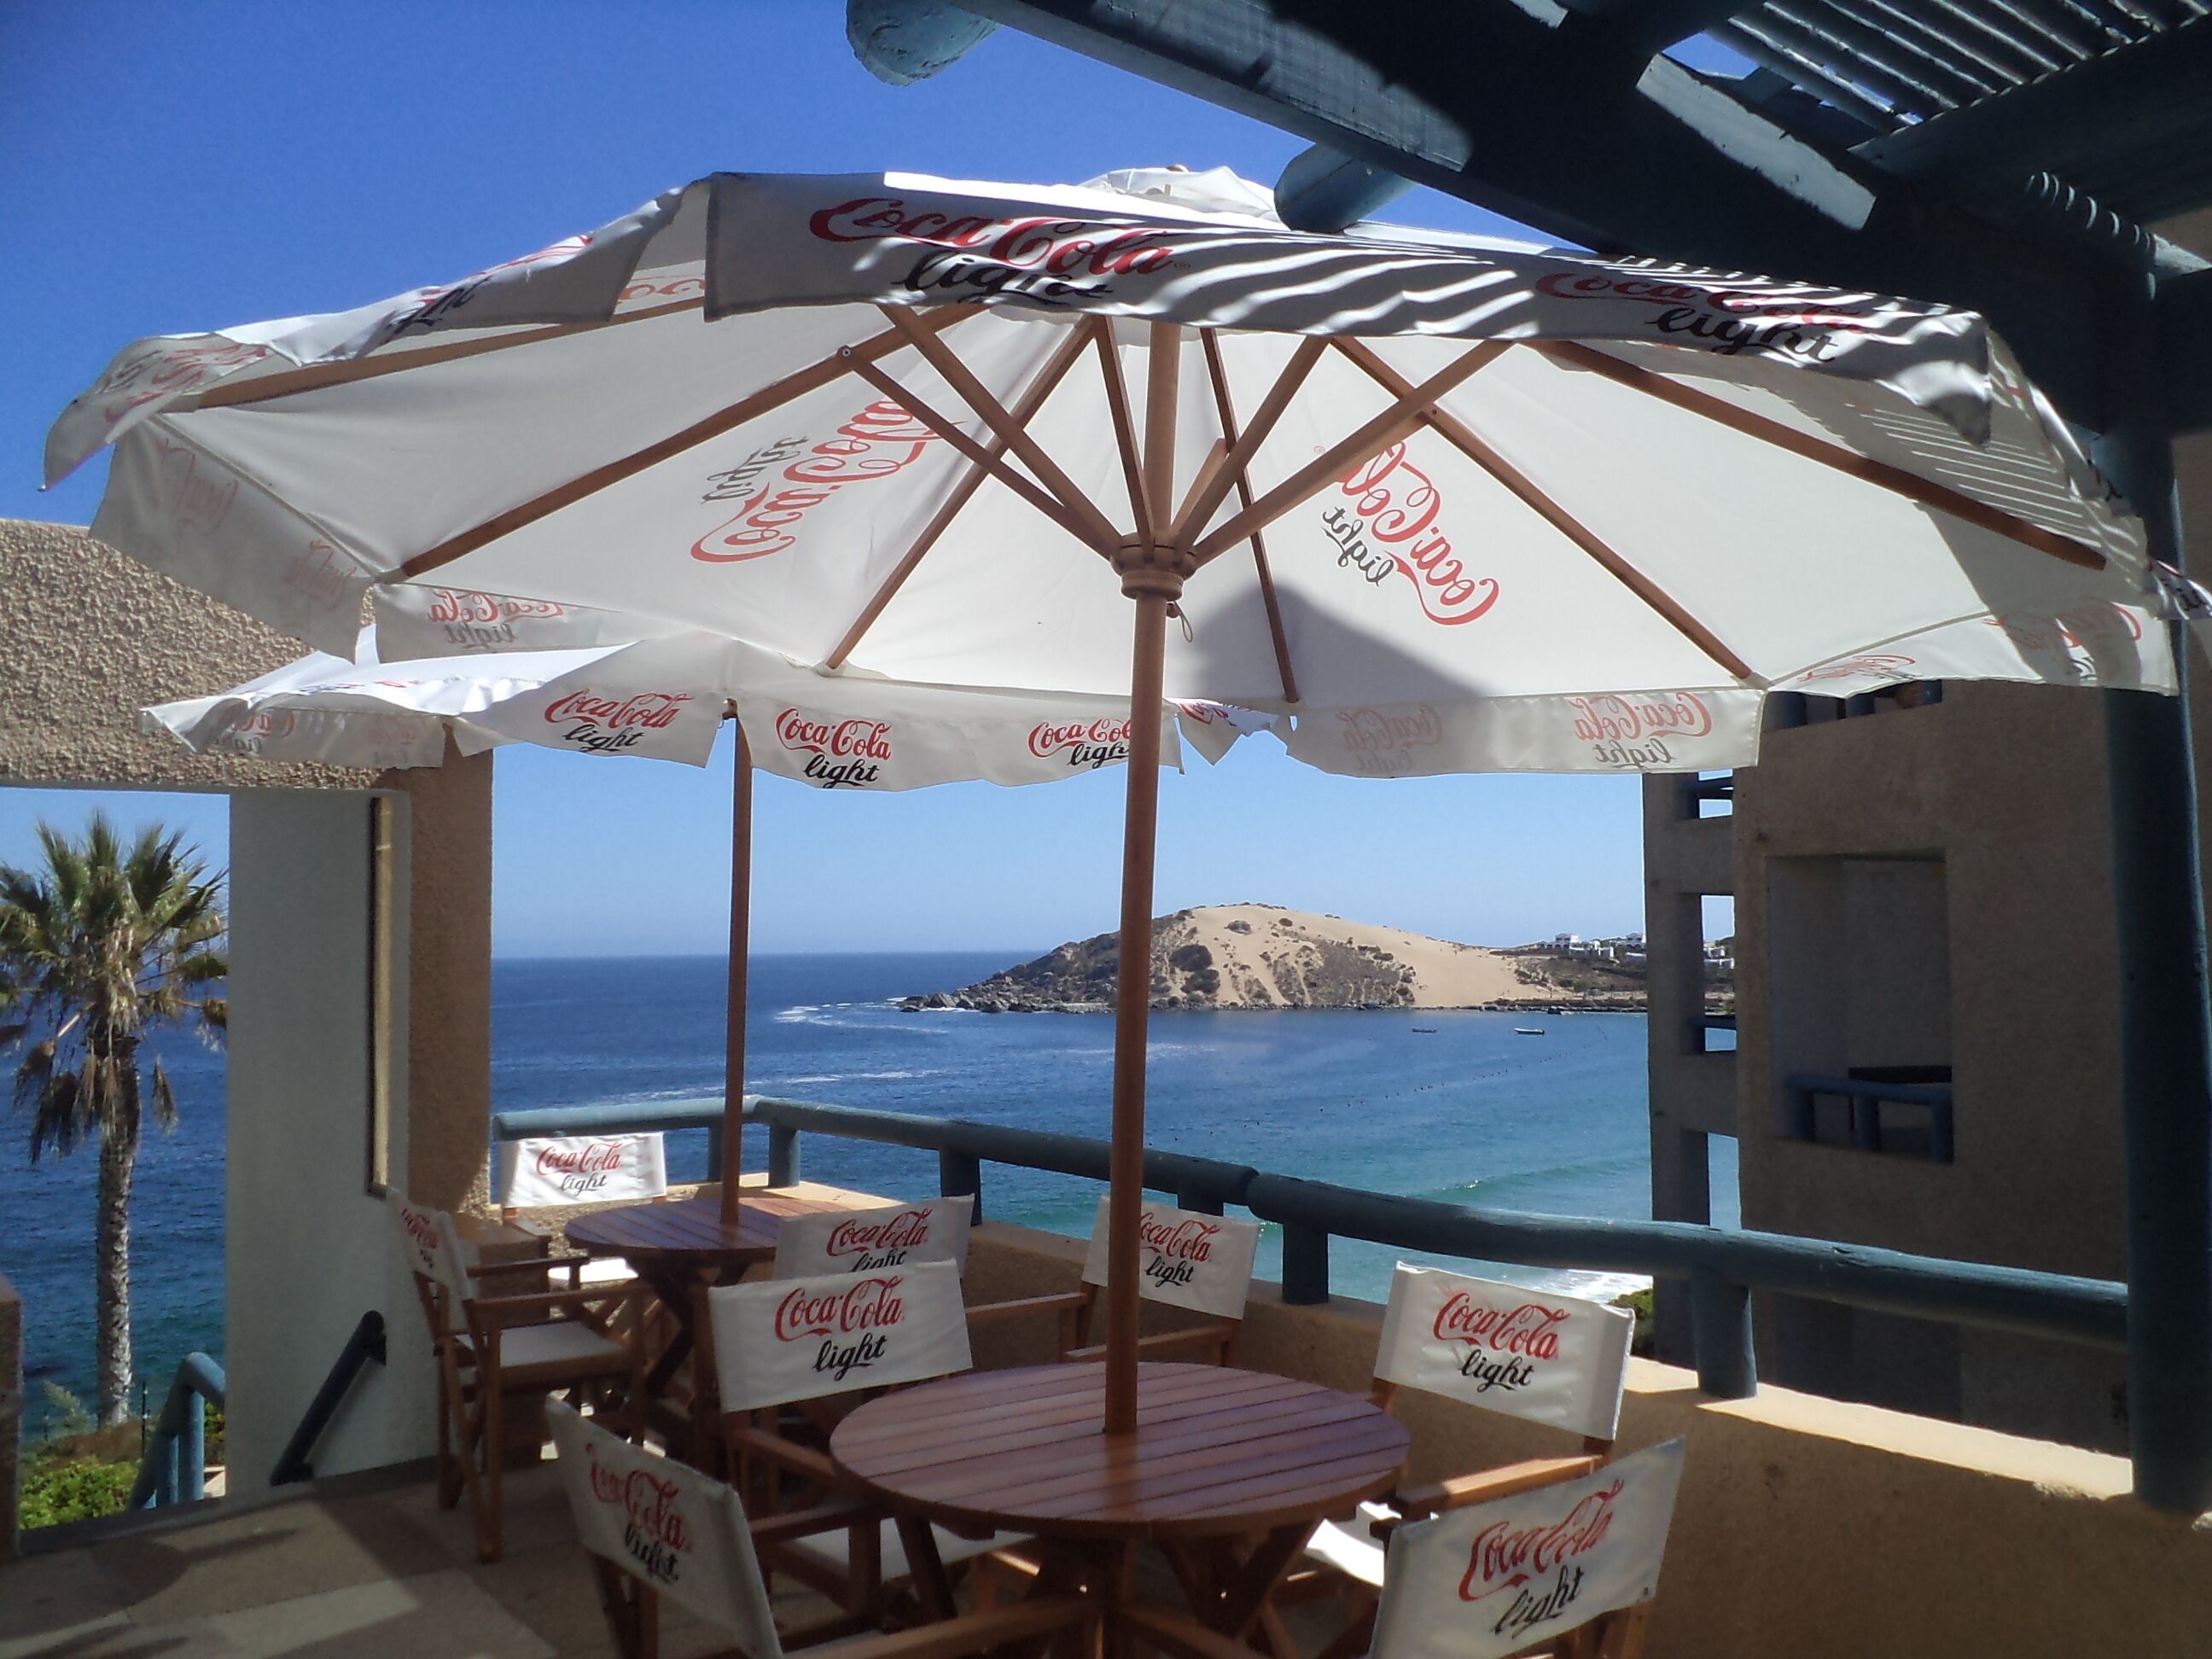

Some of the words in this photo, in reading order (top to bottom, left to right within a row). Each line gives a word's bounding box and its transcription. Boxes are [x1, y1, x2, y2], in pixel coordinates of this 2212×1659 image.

[810, 197, 1191, 275] Coca-Cola
[1646, 306, 1842, 363] light
[544, 688, 695, 730] Coca-Cola
[562, 724, 645, 753] light
[775, 707, 893, 761] Coca-Cola
[1027, 717, 1132, 759] Coca-Col
[1066, 741, 1131, 770] ligh
[803, 754, 881, 789] light
[536, 1142, 624, 1176] Coca-Cola
[560, 1173, 608, 1196] light
[826, 1208, 933, 1257] Coca-Cola
[1144, 1255, 1194, 1288] light
[774, 1275, 905, 1342] Coca-Cola
[1433, 1291, 1570, 1360] Coca-Cola
[812, 1332, 888, 1381] light
[1458, 1349, 1535, 1394] light
[1458, 1479, 1625, 1602] Coca-Cola
[1490, 1565, 1584, 1639] light
